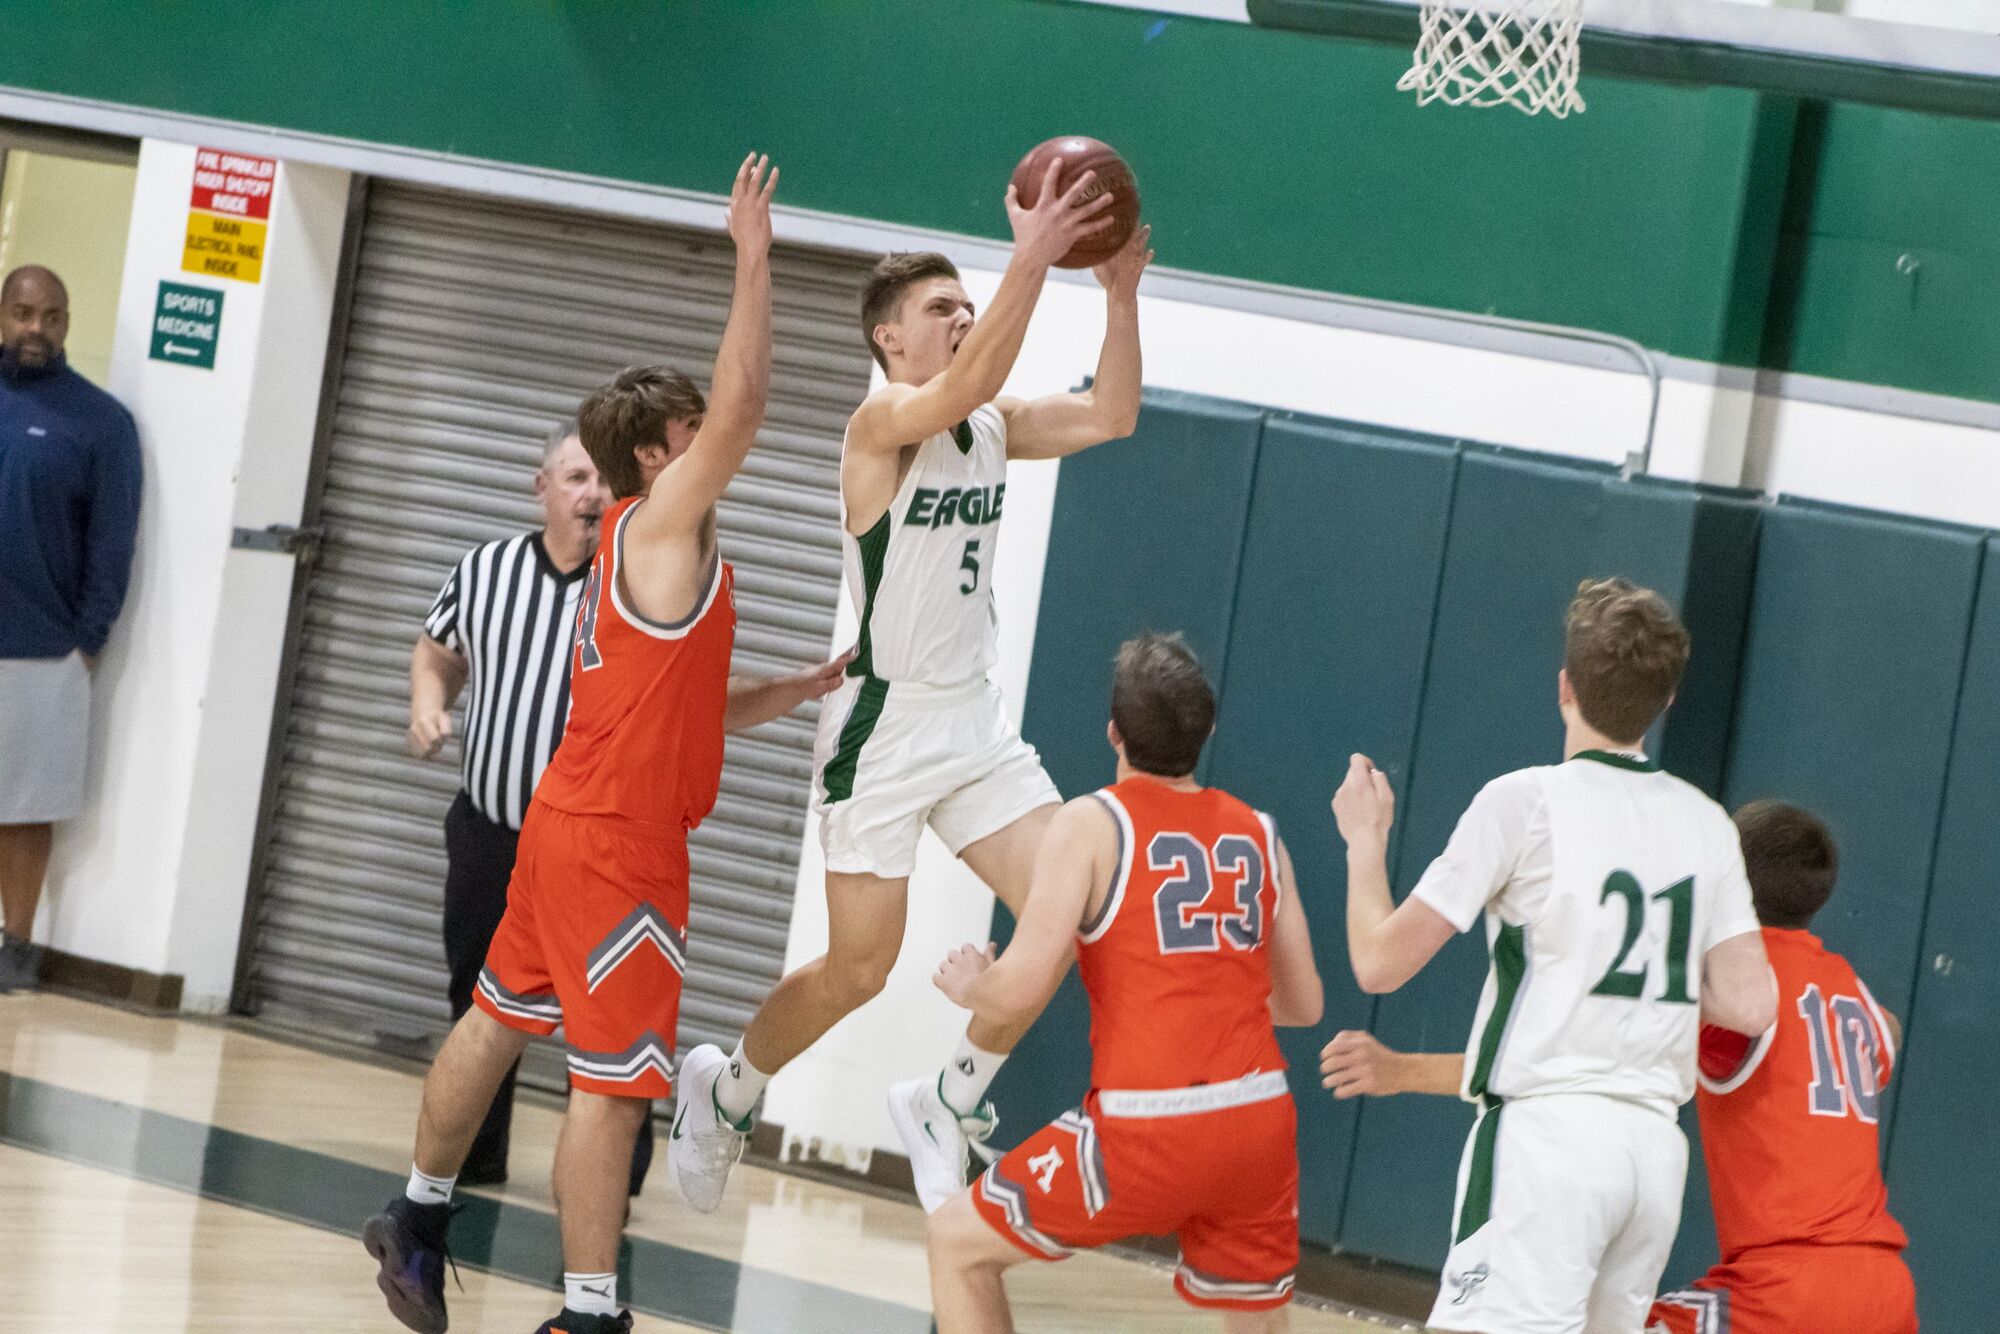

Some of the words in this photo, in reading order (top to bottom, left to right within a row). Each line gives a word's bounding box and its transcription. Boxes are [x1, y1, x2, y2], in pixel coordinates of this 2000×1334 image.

[219, 154, 274, 178] SPRINKLER
[211, 192, 249, 215] INSIDE
[213, 219, 241, 237] MAIN
[204, 256, 239, 277] INSIDE
[163, 292, 215, 317] SPORTS
[157, 315, 215, 341] MEDICINE
[959, 539, 980, 595] 5
[1146, 831, 1264, 955] 23
[1588, 867, 1698, 1004] 21
[1797, 982, 1880, 1124] 10
[1027, 1145, 1064, 1194] A
